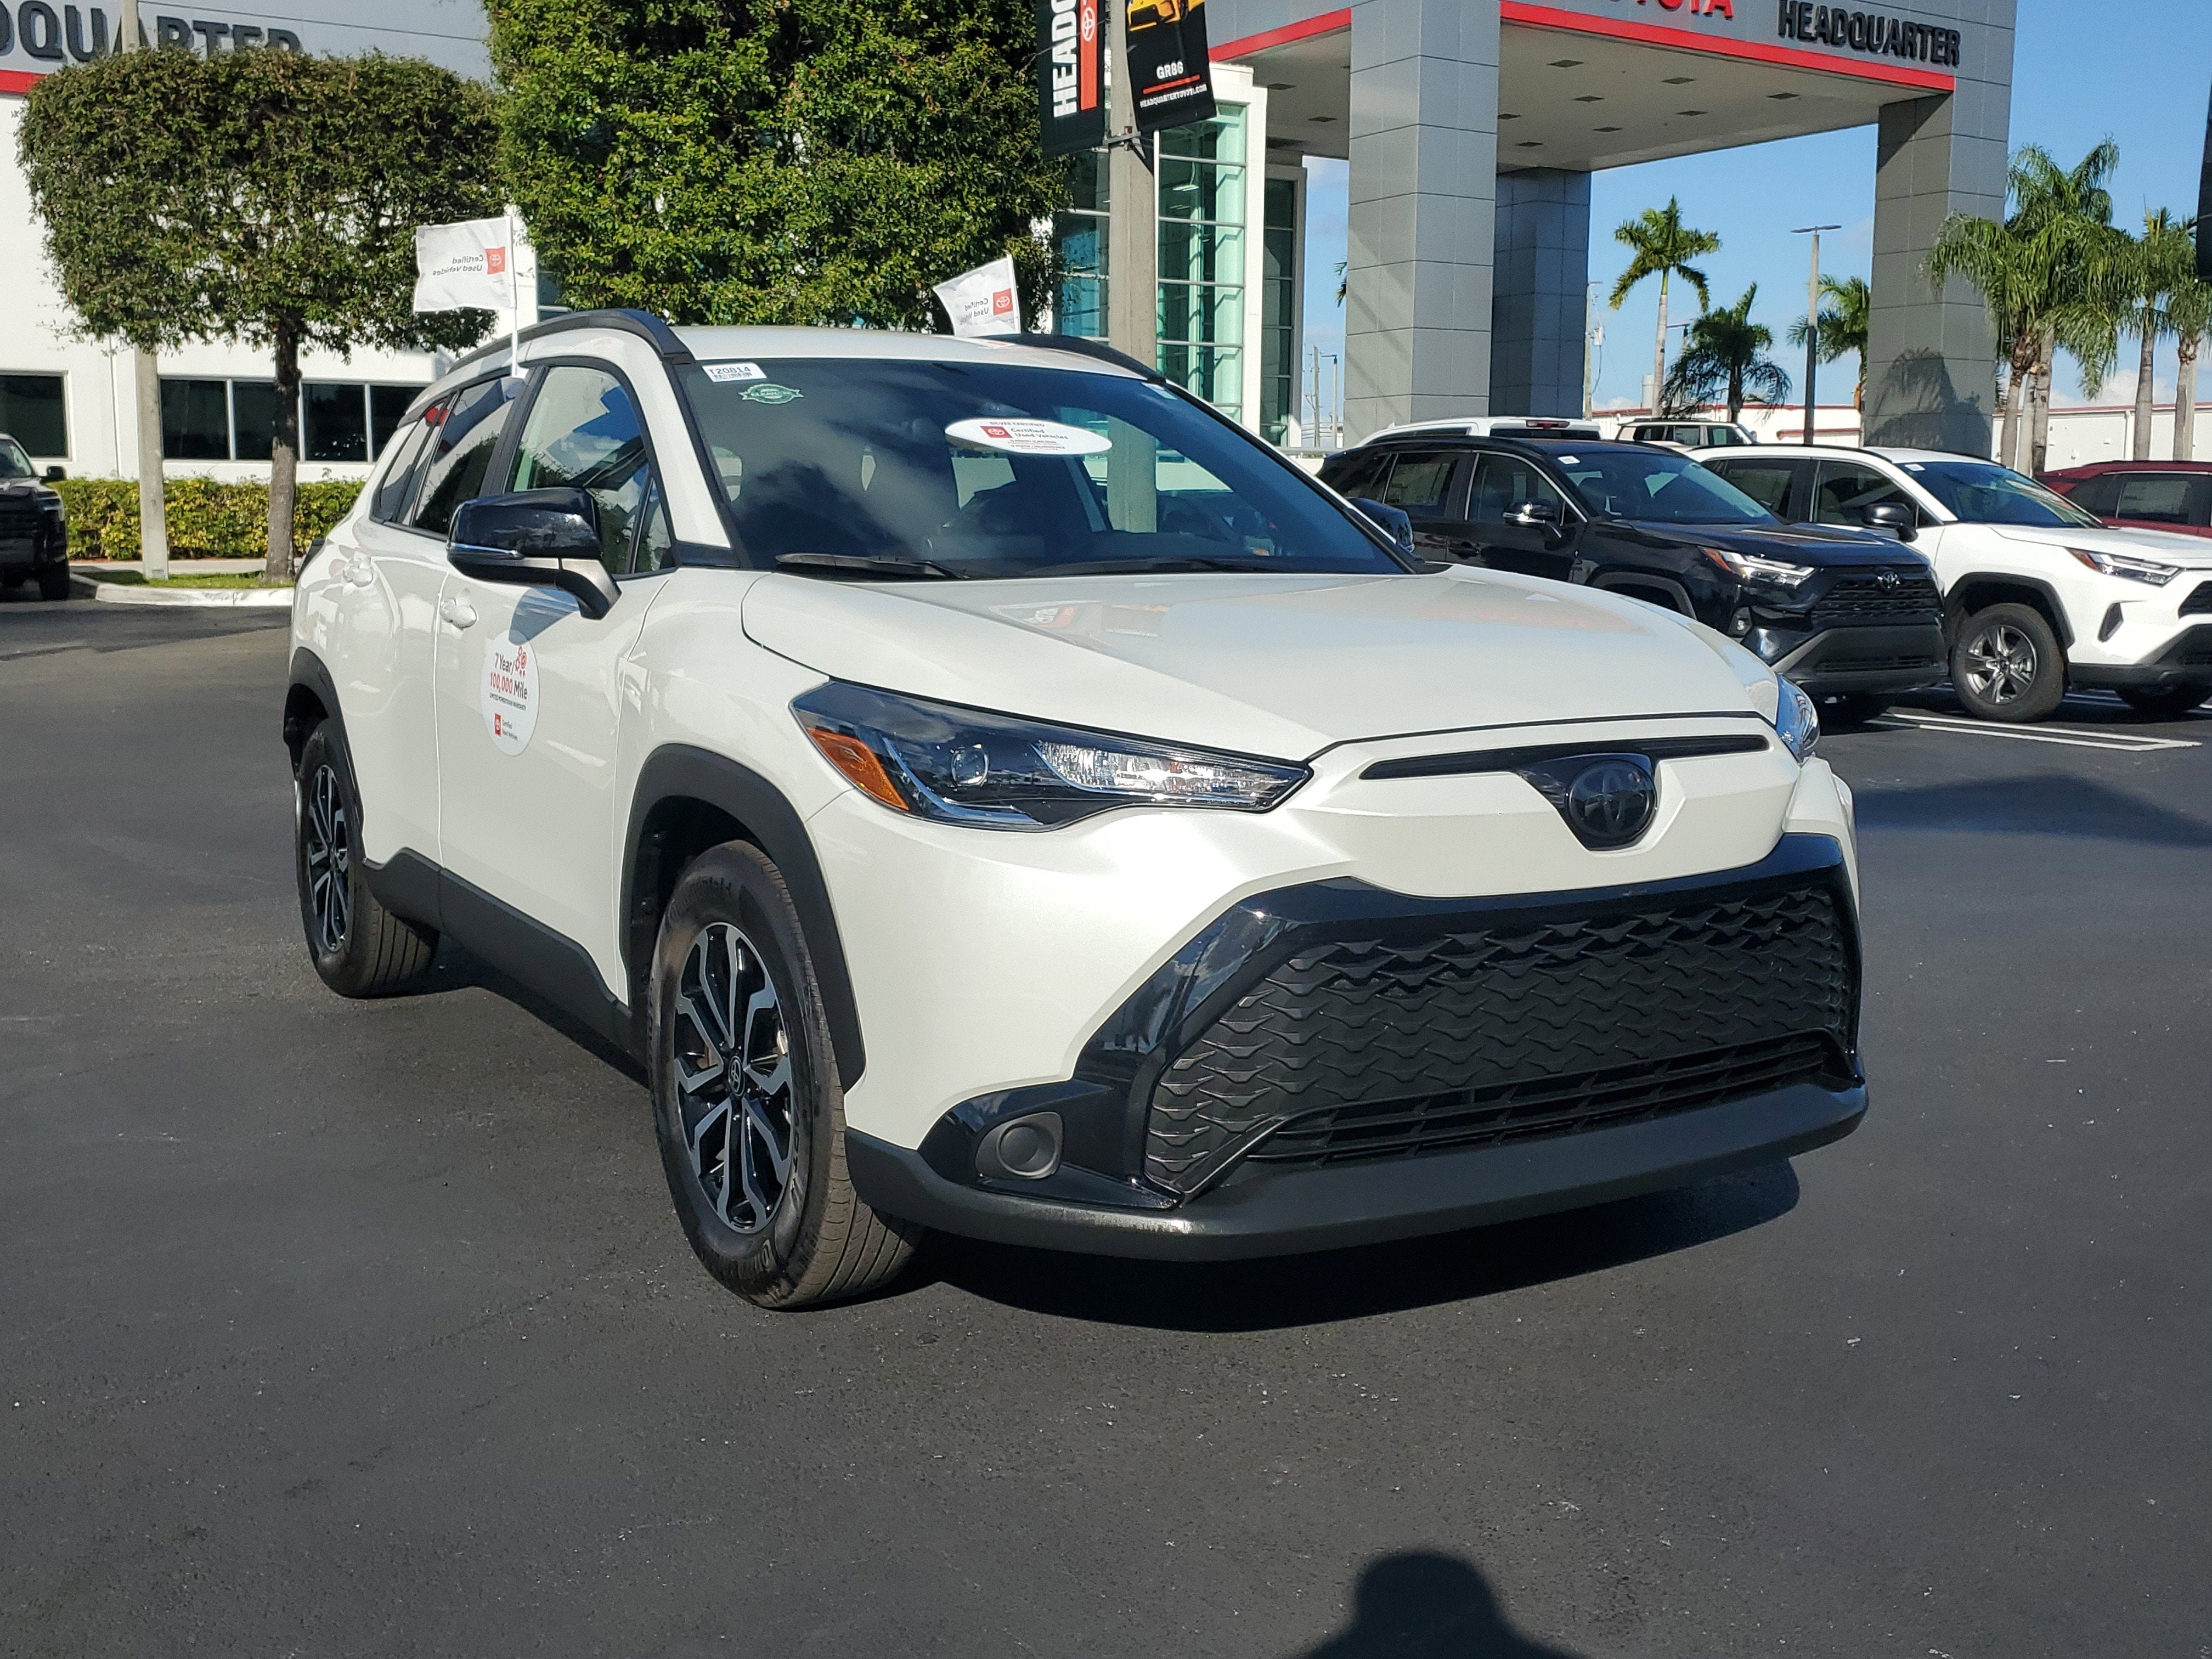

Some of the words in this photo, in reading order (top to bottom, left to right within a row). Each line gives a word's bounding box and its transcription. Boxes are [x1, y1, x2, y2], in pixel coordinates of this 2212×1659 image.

[1778, 0, 1961, 67] HEADQUARTER
[1156, 61, 1184, 79] GR86
[495, 652, 499, 668] 7
[490, 672, 513, 695] 100,000
[514, 680, 528, 700] Mile
